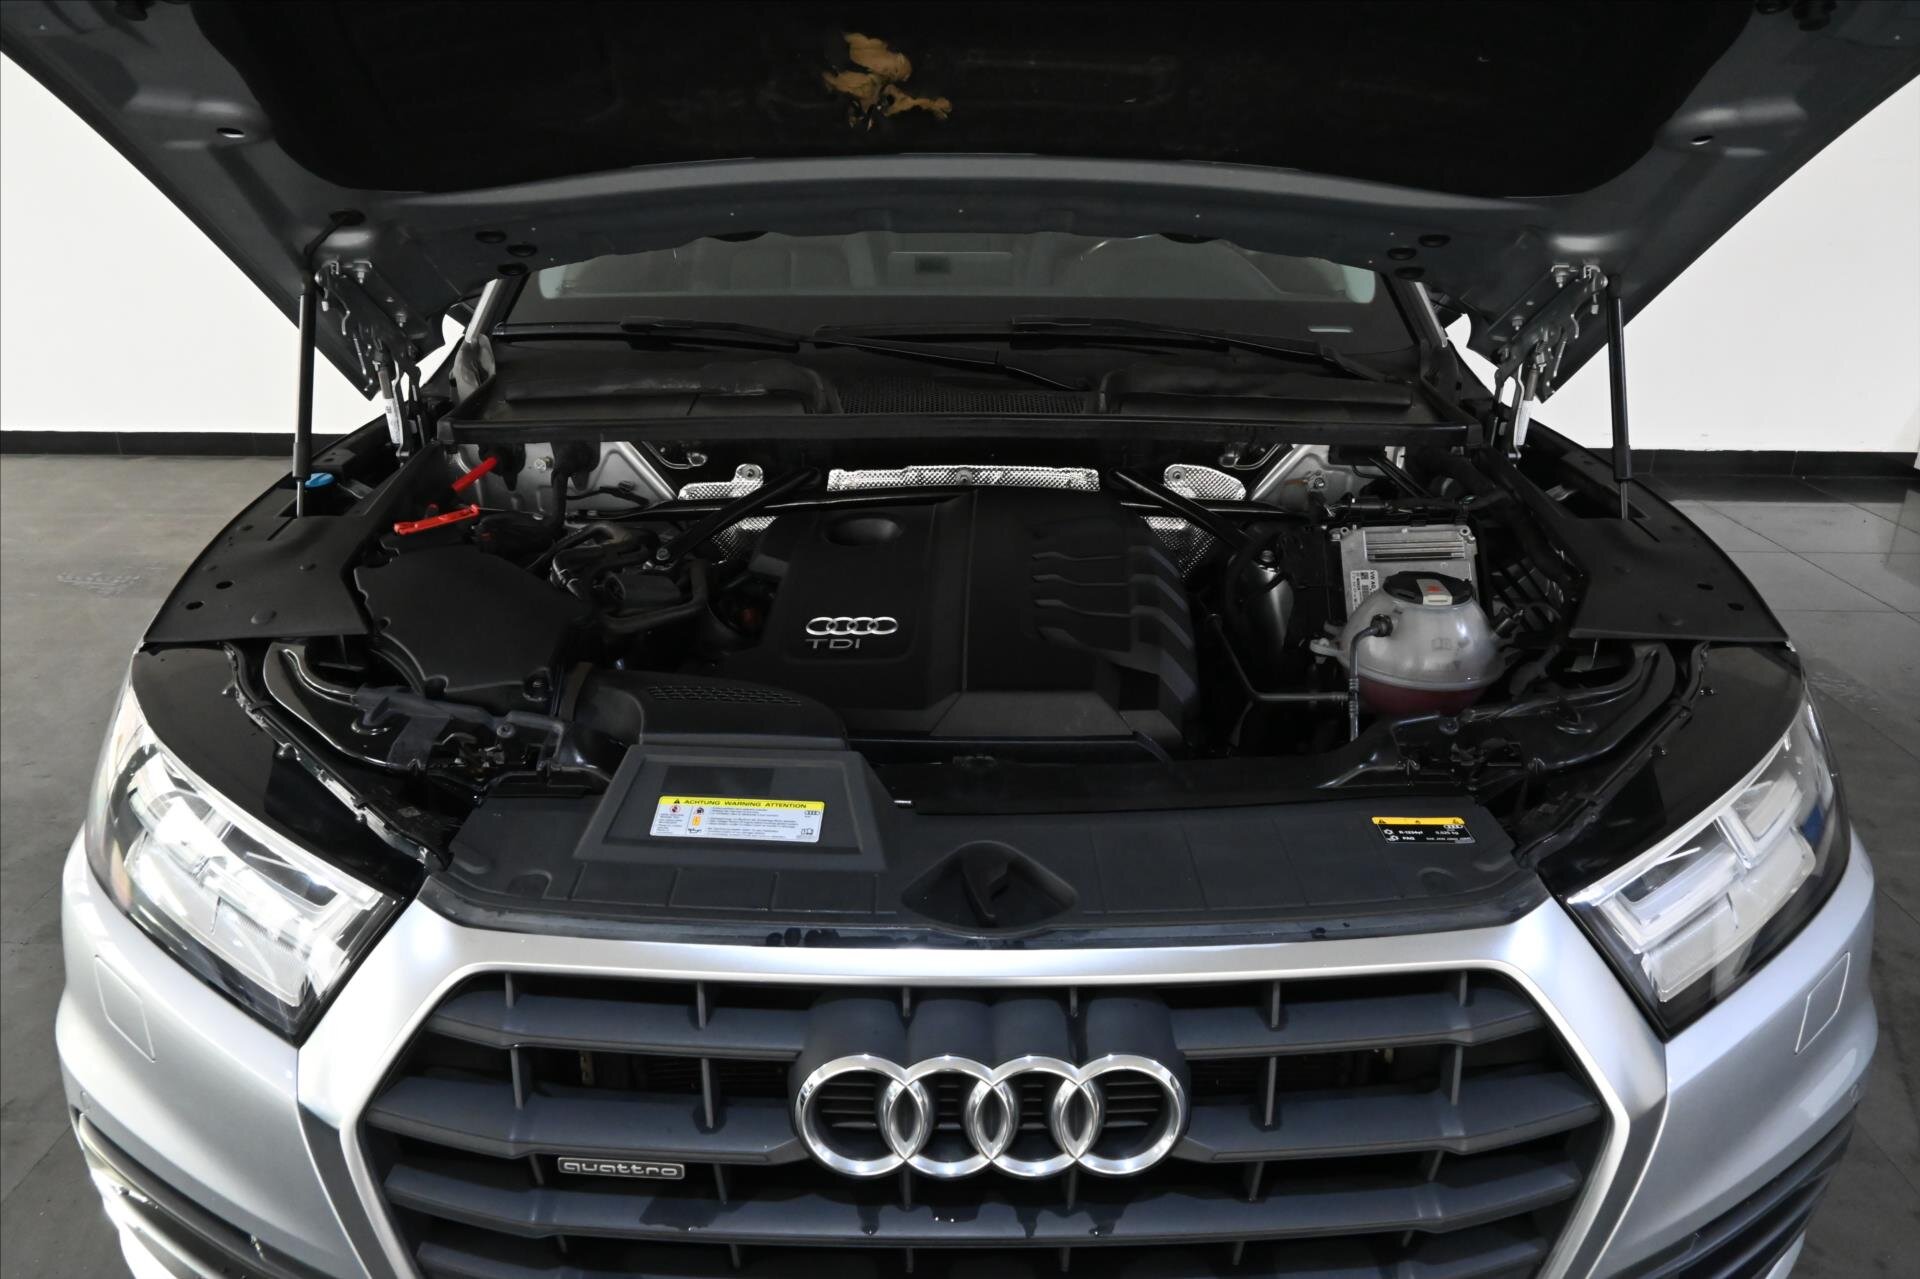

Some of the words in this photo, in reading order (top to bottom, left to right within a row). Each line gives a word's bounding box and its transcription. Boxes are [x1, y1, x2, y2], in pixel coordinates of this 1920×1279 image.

[805, 638, 861, 649] TDI
[764, 801, 807, 809] ATTENTION
[563, 1162, 678, 1176] quattro
